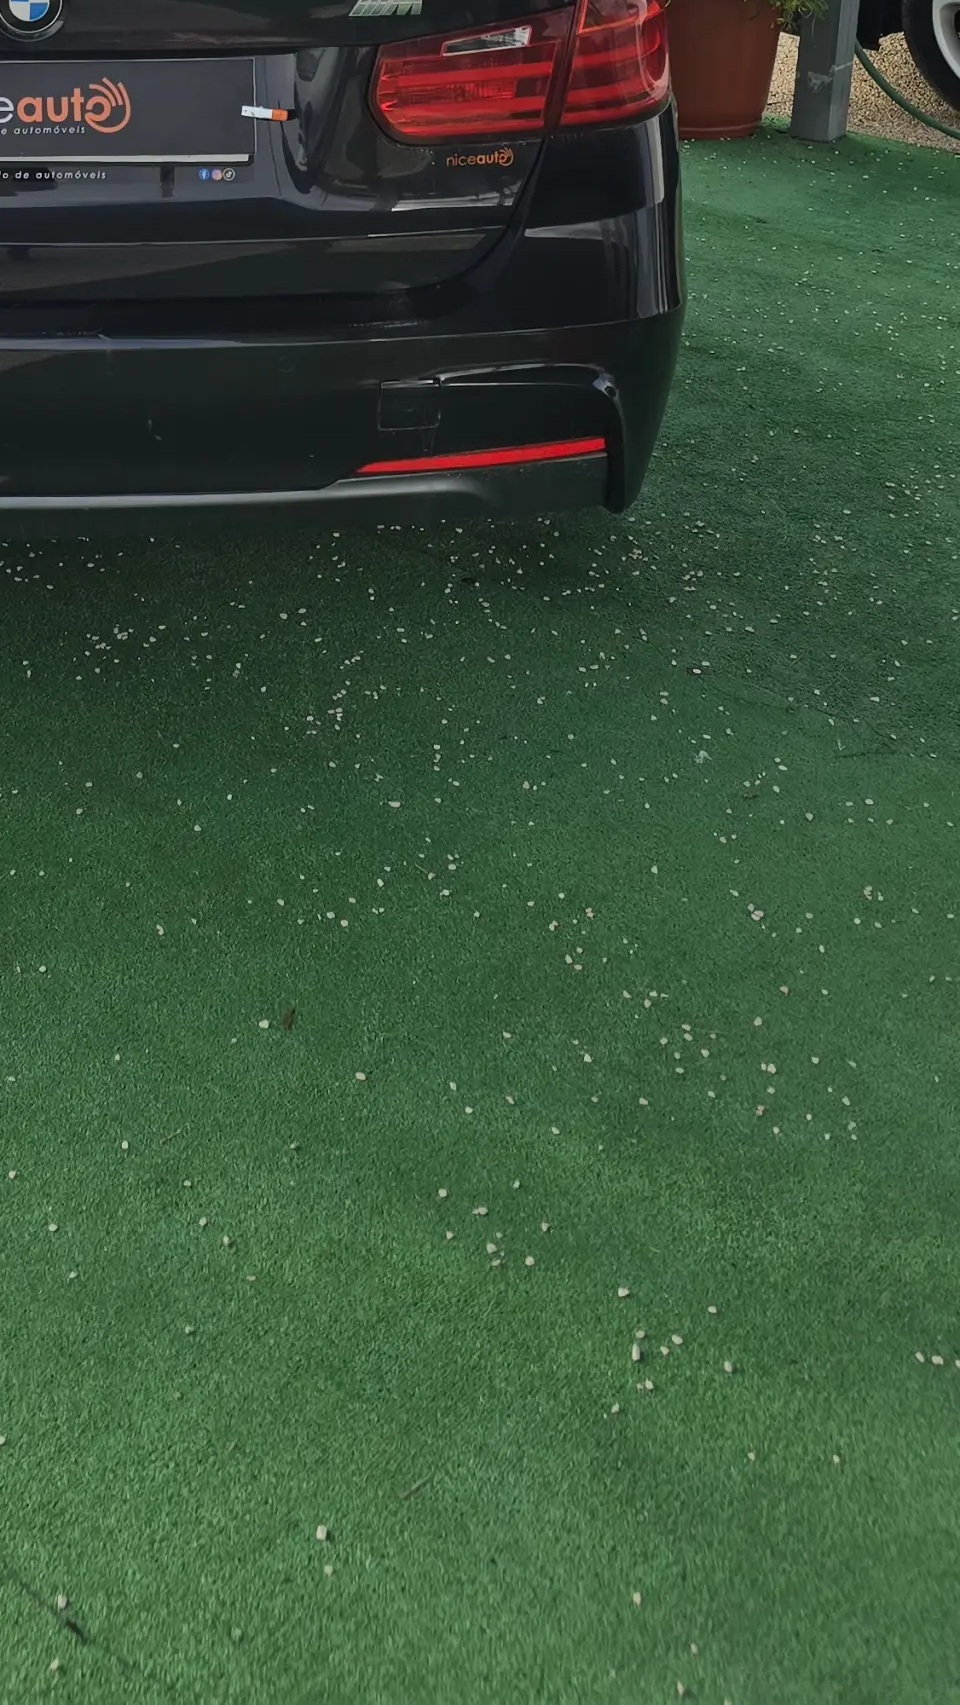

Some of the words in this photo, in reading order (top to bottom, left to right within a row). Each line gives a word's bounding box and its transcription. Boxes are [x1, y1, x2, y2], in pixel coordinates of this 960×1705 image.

[14, 125, 86, 135] automóveis
[446, 147, 514, 167] niceauto
[15, 170, 30, 179] de
[35, 170, 107, 180] automóveis
